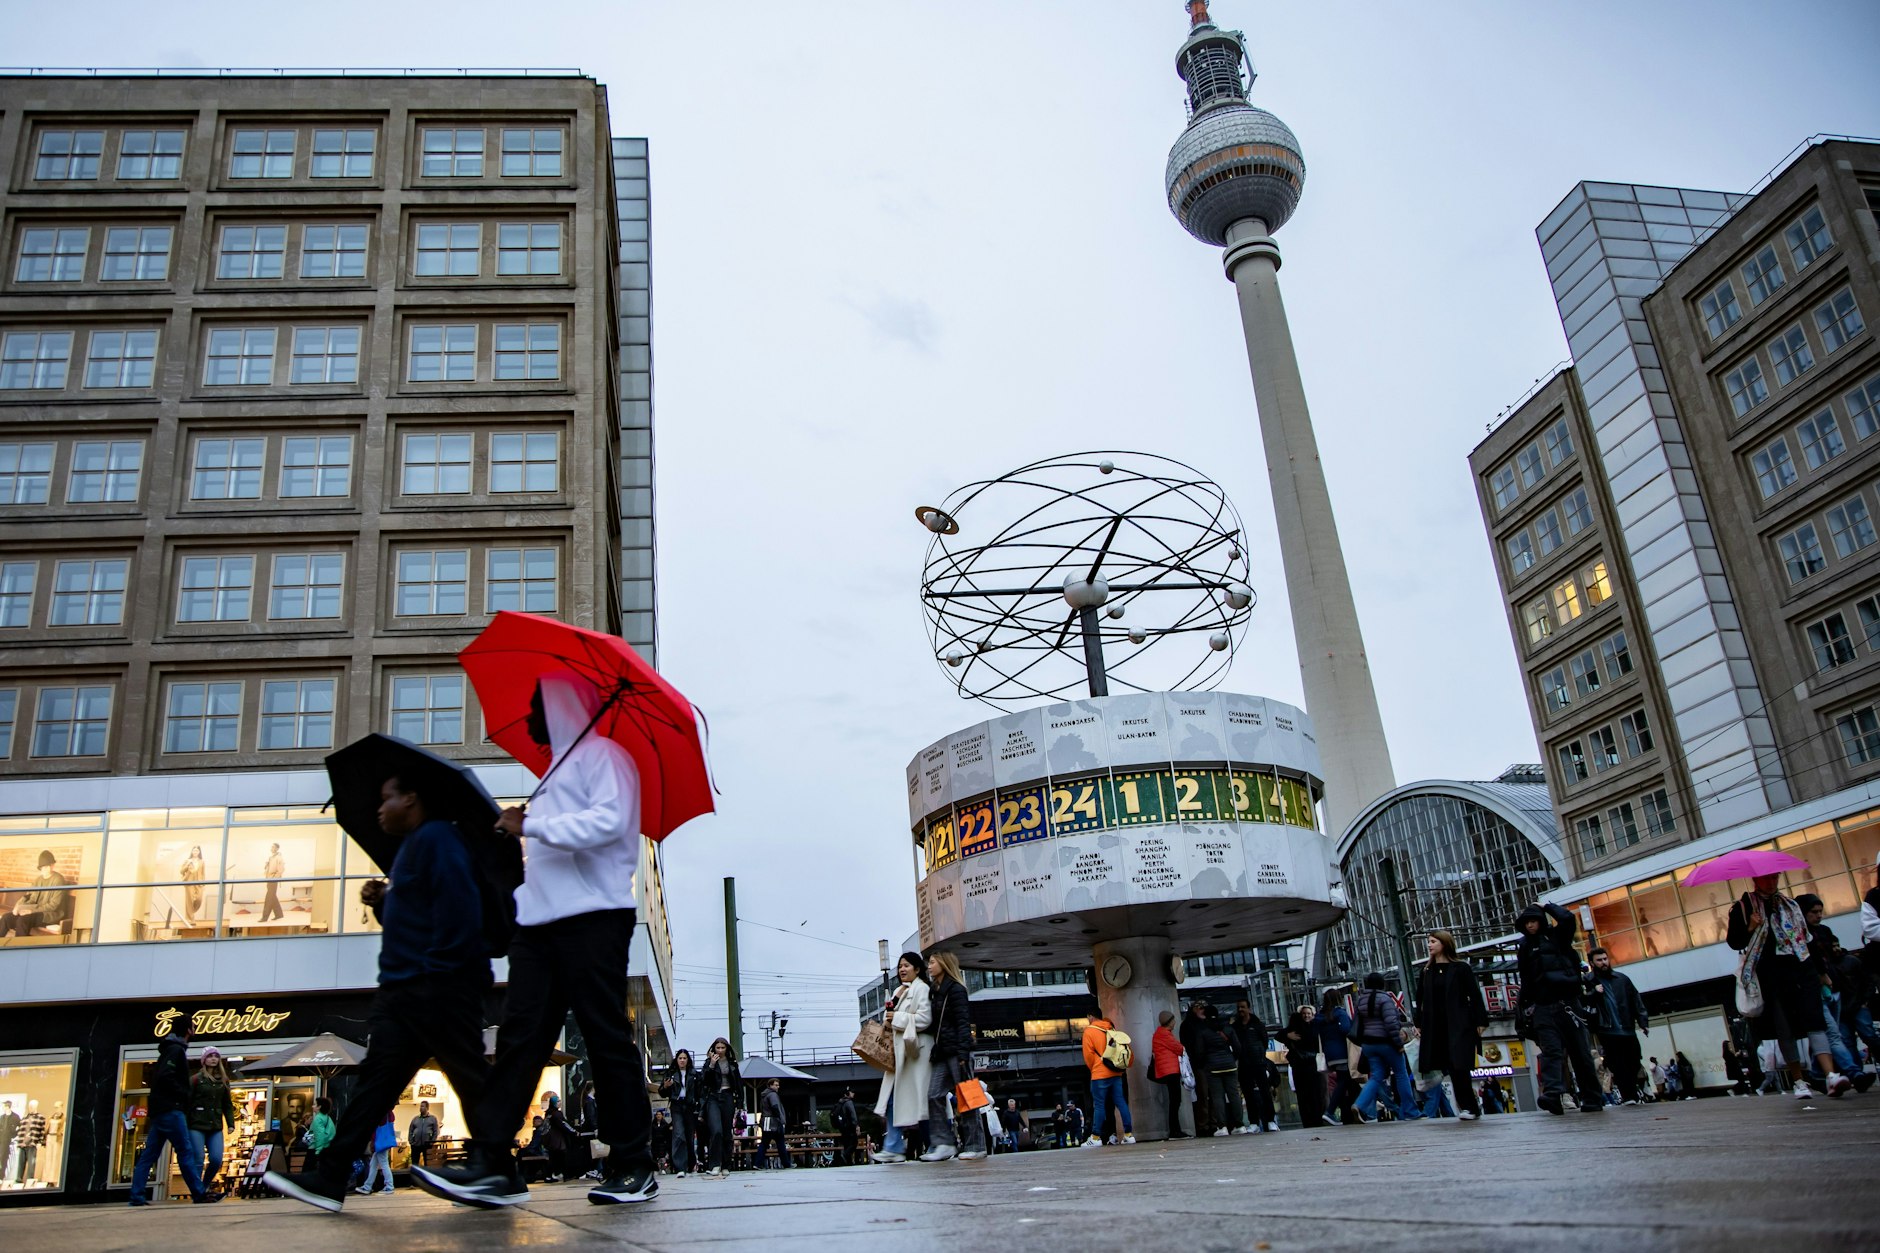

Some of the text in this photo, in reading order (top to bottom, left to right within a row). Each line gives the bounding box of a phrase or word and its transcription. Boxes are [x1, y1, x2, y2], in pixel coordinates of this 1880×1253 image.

[1050, 717, 1096, 729] KRASNOJARSK
[1122, 718, 1149, 726] IRKUTSK
[1008, 730, 1024, 739] OMSK
[1117, 731, 1157, 740] ULAN-BATOR
[1006, 736, 1028, 746] ALMATY
[1001, 741, 1034, 754] TASCHKENT
[1000, 748, 1037, 761] NOWOSIBIRSK
[936, 822, 955, 859] 21
[960, 808, 994, 848] 22
[1000, 796, 1042, 834] 23
[1050, 786, 1097, 824] 24
[1119, 781, 1141, 814] 1
[1176, 778, 1202, 811] 2
[1228, 779, 1250, 811] 3
[1270, 783, 1287, 815] 4
[1299, 789, 1311, 822] 5
[1140, 839, 1164, 847] PEKING
[1134, 845, 1171, 854] SHANGHAI
[1079, 853, 1101, 861] HANOI
[1140, 853, 1167, 861] MANILA
[1075, 859, 1105, 869] BANGKOK
[1145, 860, 1165, 868] PERTH
[1070, 866, 1113, 877] PHNOM PENH
[1138, 867, 1174, 875] HONGKONG
[1013, 876, 1038, 887] RANGUN
[1077, 874, 1108, 883] JAKARTA
[1132, 873, 1182, 883] KUALA LUMPUR
[971, 879, 993, 890] KARACHI
[1023, 883, 1044, 893] DHAKA
[1140, 881, 1174, 890] SINGAPUR
[191, 1005, 291, 1035] Tchibo
